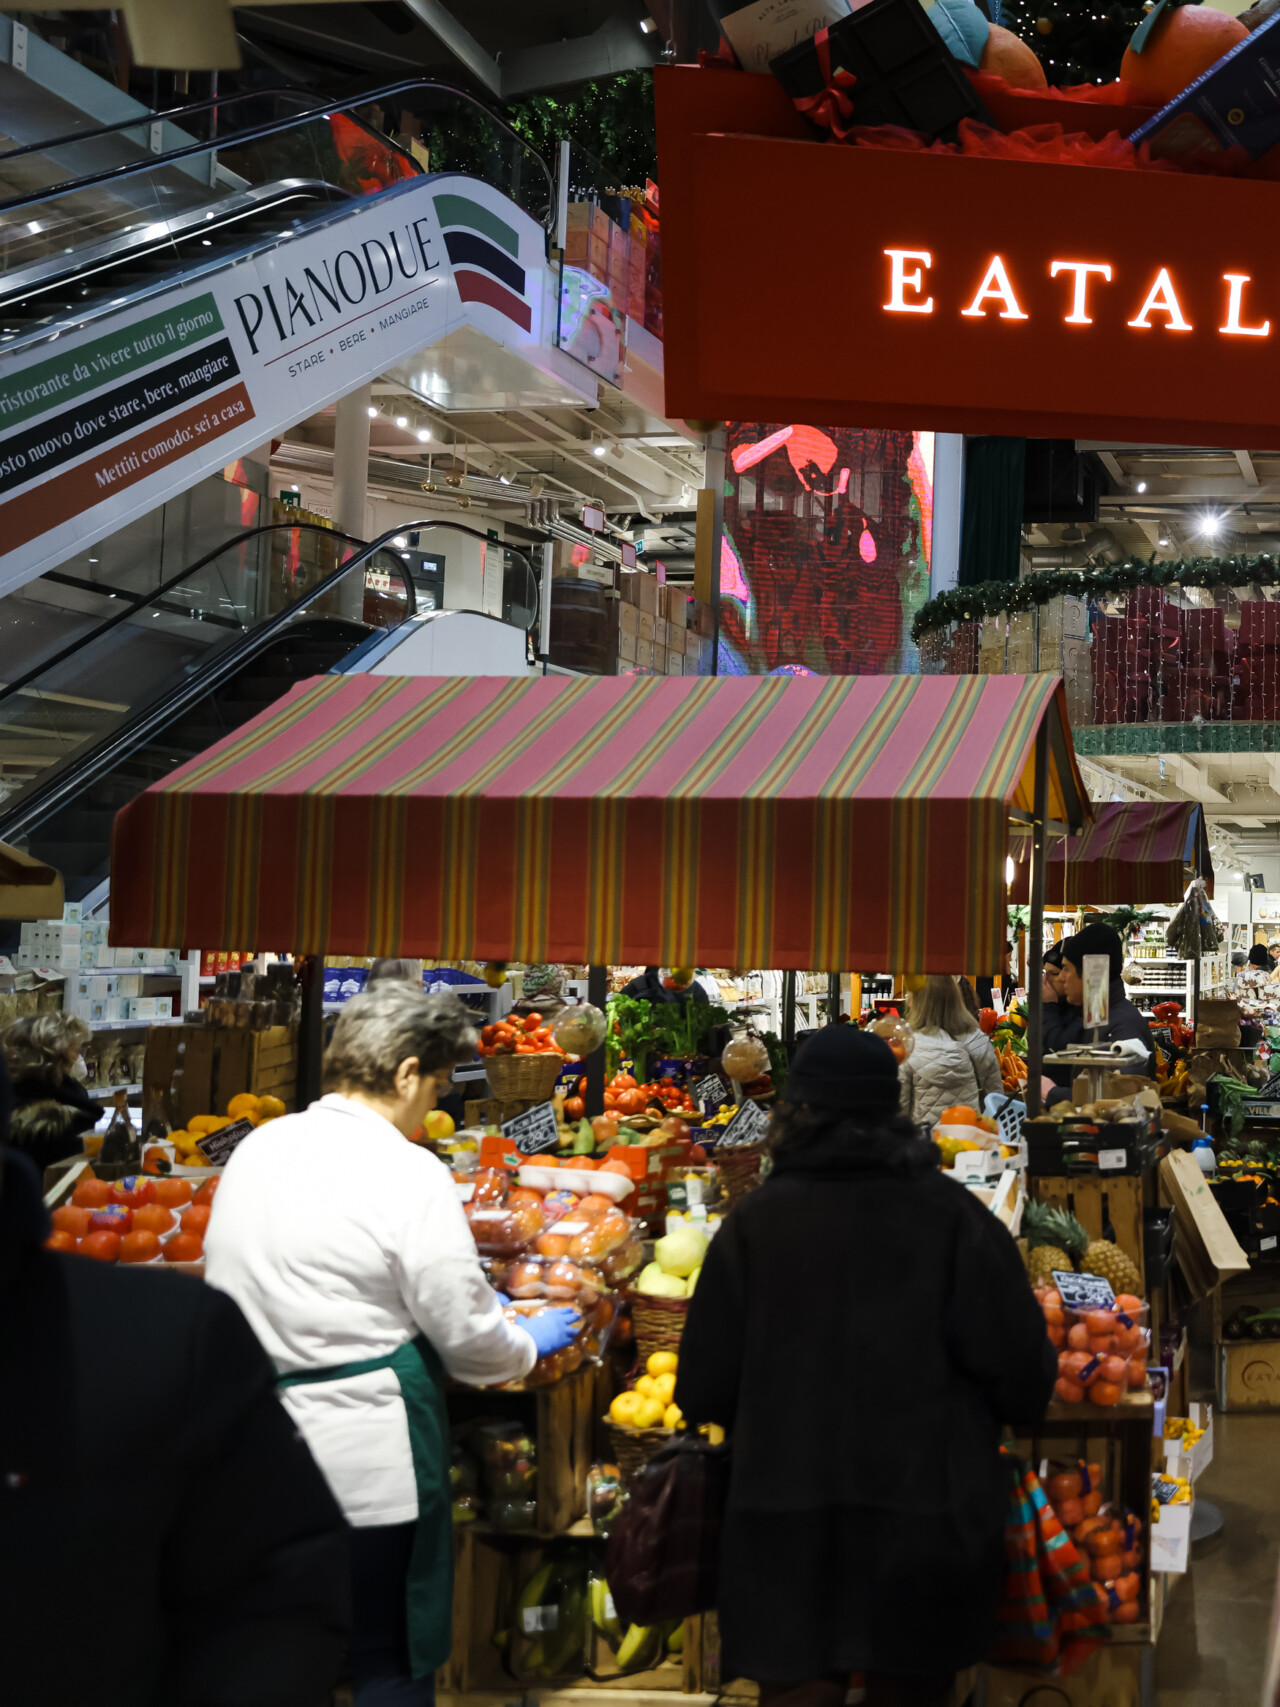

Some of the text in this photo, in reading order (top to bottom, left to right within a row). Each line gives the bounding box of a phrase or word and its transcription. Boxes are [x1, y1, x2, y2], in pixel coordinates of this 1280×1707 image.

[233, 217, 440, 355] PIANODUE
[288, 297, 430, 378] STARE BERE MANGIARE
[0, 310, 214, 414] ristorante da vivere tutto il giorno
[27, 431, 73, 463] nuovo
[73, 413, 107, 440] dove
[108, 396, 147, 424] stare,
[144, 381, 179, 405] bere,
[178, 354, 230, 389] mangiare
[95, 399, 246, 488] Mettiti comodo: sei a casa
